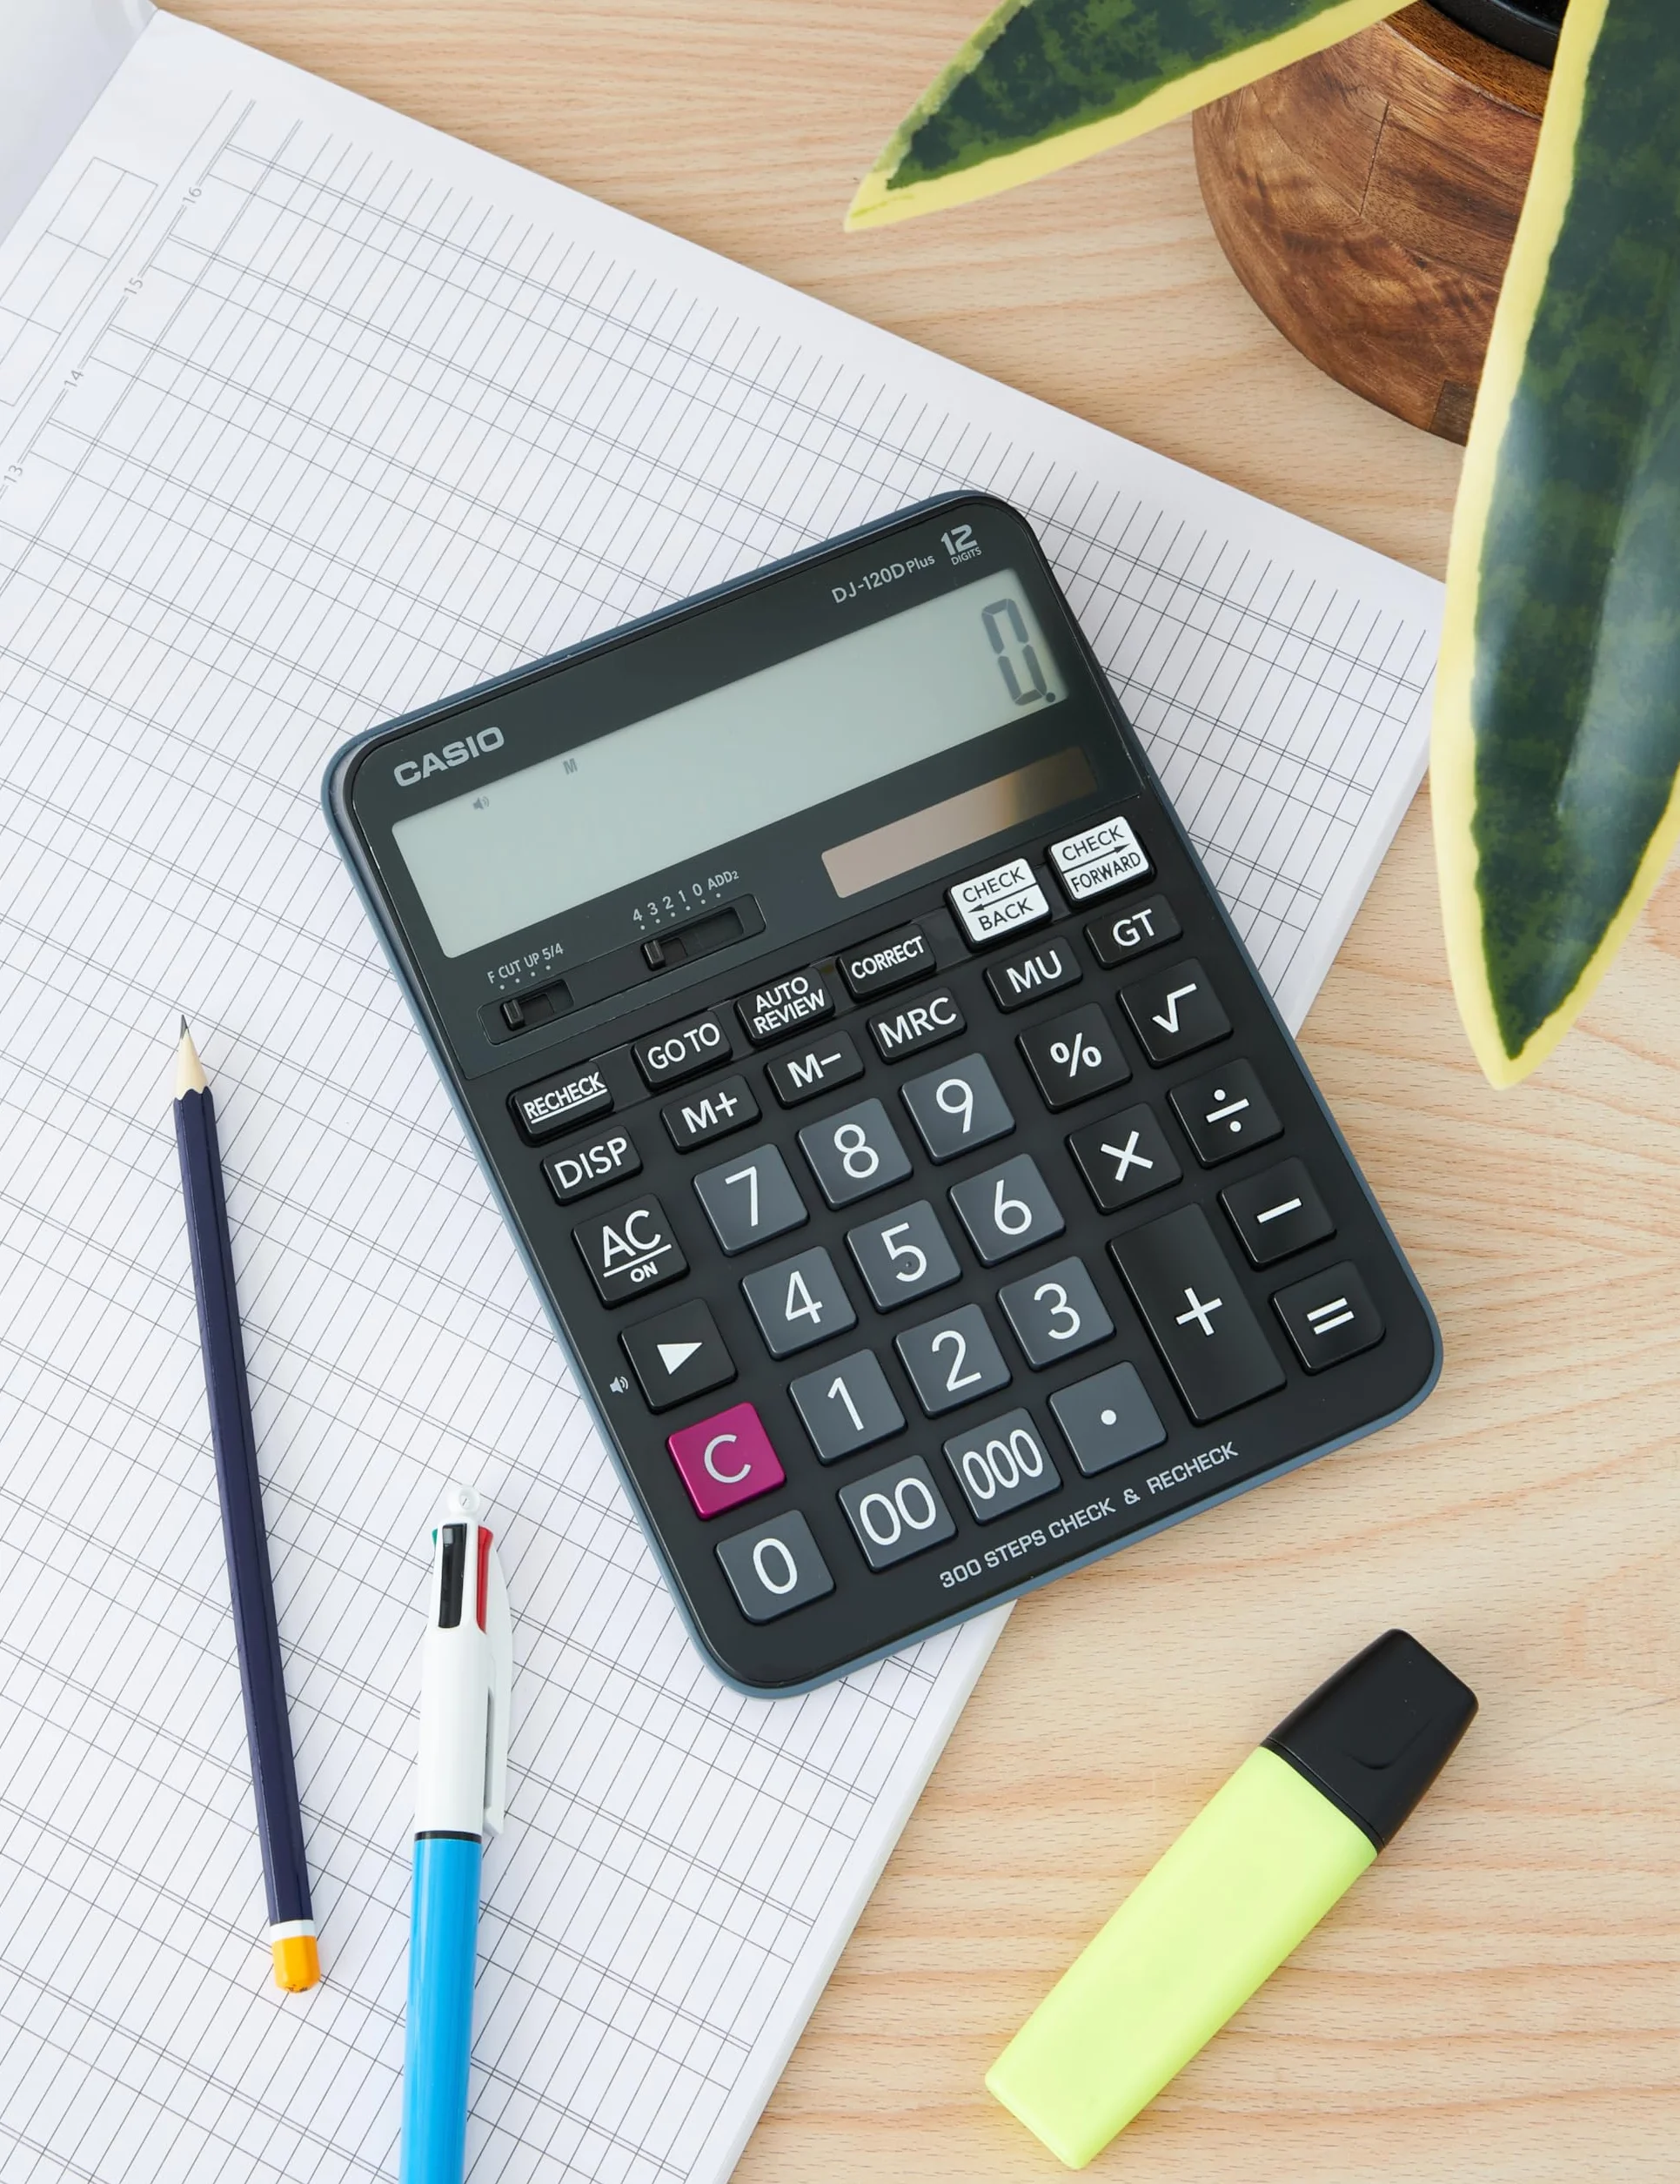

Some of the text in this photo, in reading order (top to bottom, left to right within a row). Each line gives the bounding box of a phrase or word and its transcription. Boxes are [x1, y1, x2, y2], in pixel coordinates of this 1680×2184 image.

[182, 185, 203, 207] 16
[124, 276, 144, 298] 15
[64, 368, 84, 390] 14
[3, 464, 23, 485] 13
[940, 524, 978, 555] 12
[951, 547, 982, 566] DIGITS
[832, 554, 935, 603] DJ-120D Plus
[393, 727, 505, 787] CASIO
[563, 759, 578, 775] M
[1061, 825, 1125, 861] CHECK
[962, 867, 1026, 904] CHECK
[1071, 852, 1141, 894] FORWARD
[633, 908, 643, 921] 4
[647, 902, 659, 915] 3
[662, 896, 674, 909] 2
[678, 890, 687, 902] 1
[693, 883, 703, 896] 0
[979, 898, 1034, 932] BACK
[1111, 908, 1156, 947] GT
[487, 942, 564, 984] F CUT UP 5/4
[851, 936, 925, 980] CORRECT
[1006, 951, 1062, 995] MU
[753, 989, 826, 1035] REVIEW
[755, 976, 809, 1013] AUTO
[877, 996, 957, 1048] MRC
[647, 1023, 720, 1069] GO TO
[1049, 1033, 1102, 1079] %
[523, 1071, 606, 1120] RECHECK
[681, 1091, 738, 1133] M+
[935, 1078, 975, 1134] 9
[554, 1136, 627, 1189] DISP
[833, 1123, 879, 1179] 8
[724, 1165, 759, 1227] 7
[992, 1179, 1033, 1236] 6
[601, 1209, 662, 1268] AC
[880, 1222, 927, 1283] 5
[629, 1261, 659, 1283] ON
[784, 1270, 823, 1324] 4
[1033, 1282, 1081, 1341] 3
[930, 1330, 982, 1393] 2
[827, 1377, 865, 1431] 1
[703, 1433, 752, 1484] C
[962, 1428, 1043, 1500] 000
[859, 1477, 937, 1546] 00
[939, 1442, 1239, 1590] 300 STEPS CHECK & RECHECK
[752, 1538, 799, 1595] 0
